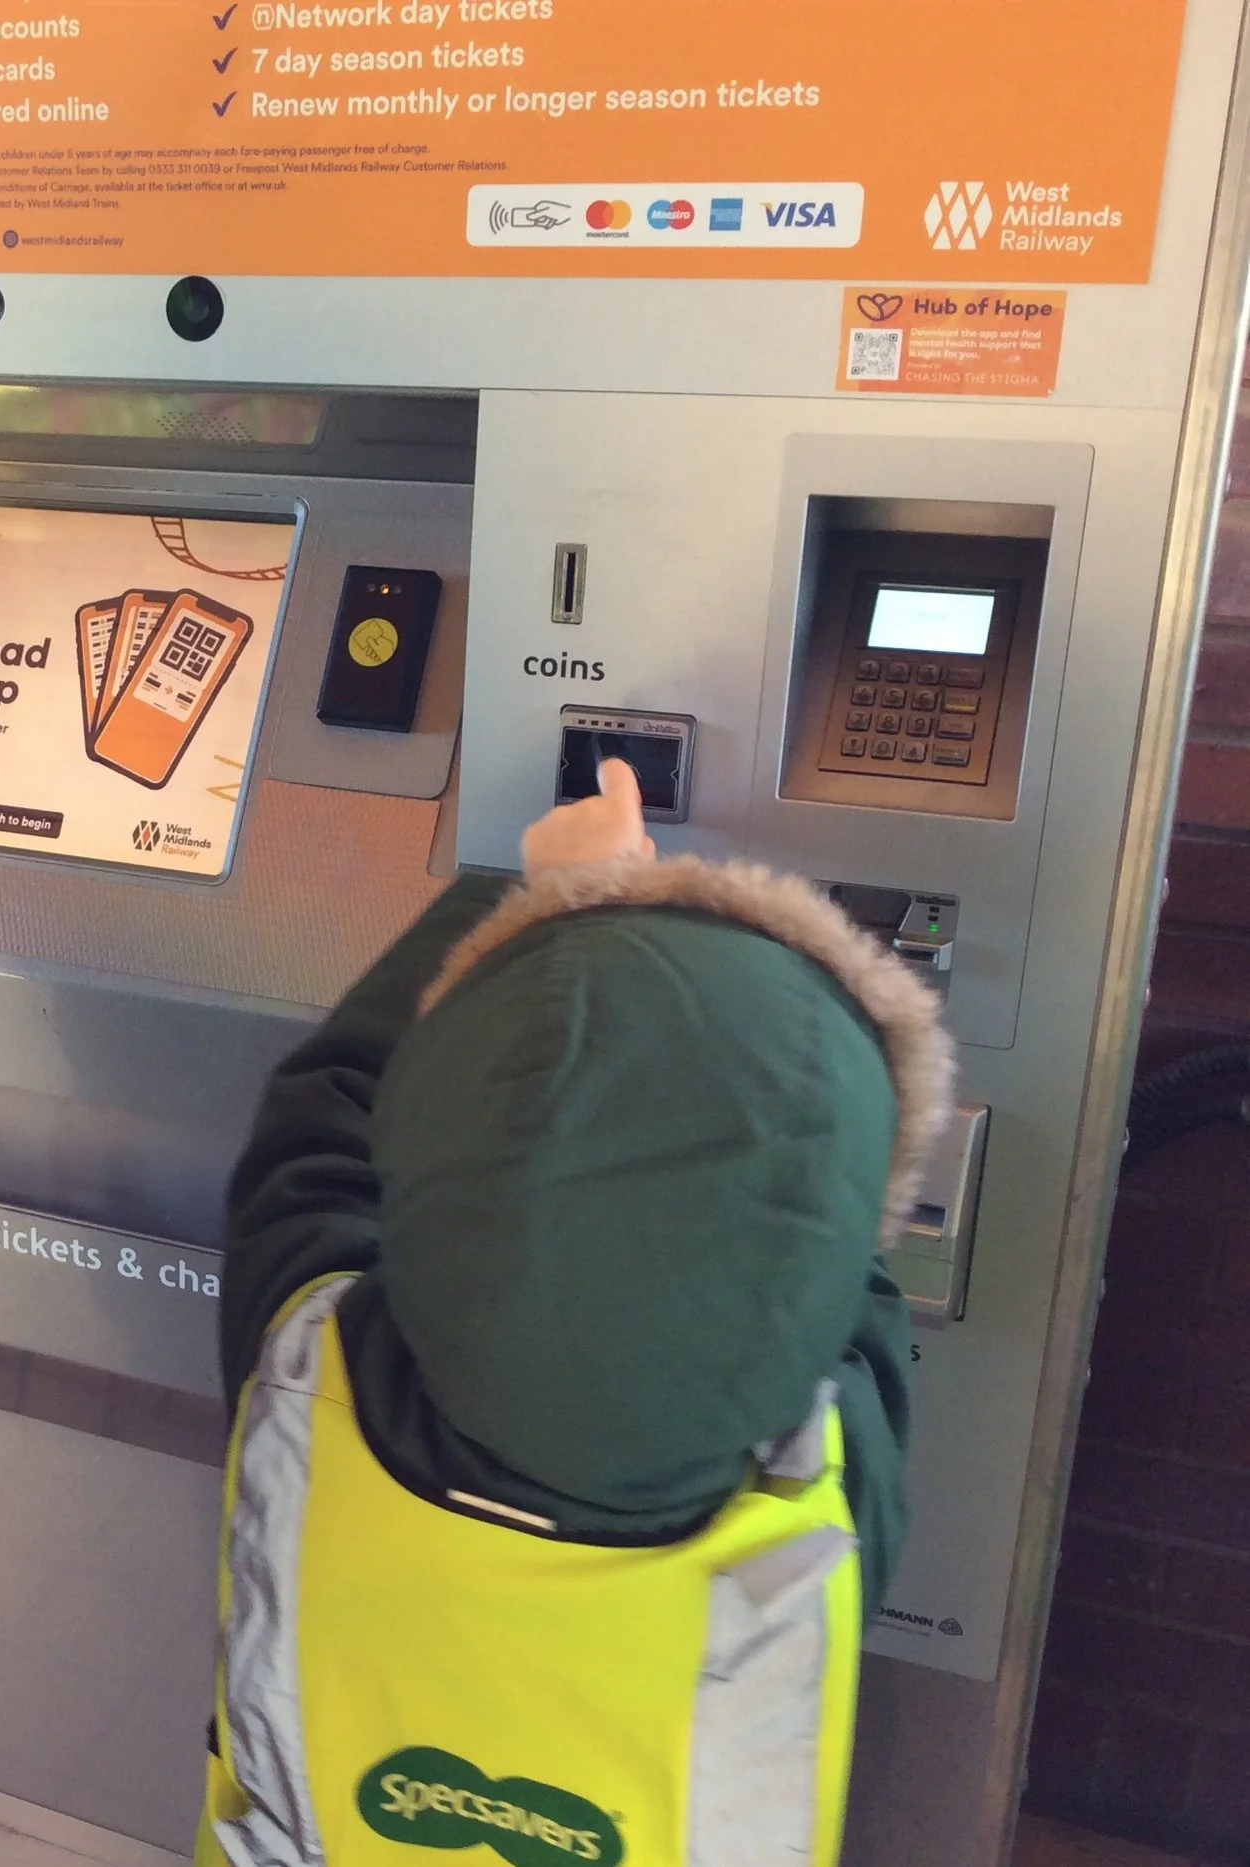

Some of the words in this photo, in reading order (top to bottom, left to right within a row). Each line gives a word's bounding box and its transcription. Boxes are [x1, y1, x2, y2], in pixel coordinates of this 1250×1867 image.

[400, 0, 450, 29] day
[458, 0, 554, 22] tickets
[251, 48, 269, 74] 7
[274, 47, 323, 78] day
[330, 49, 423, 72] season
[431, 41, 526, 69] tickets
[251, 91, 339, 118] Renew
[348, 86, 460, 120] monthly
[466, 93, 497, 113] or
[504, 85, 597, 118] longer
[605, 86, 707, 110] season
[717, 79, 821, 108] tickets
[37, 96, 110, 122] online
[0, 149, 37, 158] children
[38, 148, 65, 158] under
[76, 149, 101, 159] years
[102, 148, 113, 157] of
[114, 149, 133, 159] age
[134, 149, 153, 159] may
[156, 148, 211, 158] accompany
[214, 146, 238, 155] each
[240, 145, 297, 157] fare-paying
[299, 146, 351, 156] passenger
[354, 144, 376, 153] free
[377, 144, 390, 153] of
[391, 143, 431, 155] charge.
[31, 164, 73, 174] Relations
[75, 164, 100, 173] Team
[101, 164, 113, 175] by
[115, 163, 146, 175] calling
[148, 163, 175, 172] 0333
[177, 163, 192, 172] 311
[193, 162, 221, 172] 0039
[222, 164, 234, 172] or
[235, 162, 280, 173] Freepost
[282, 162, 308, 171] West
[310, 161, 358, 171] Midlands
[360, 161, 401, 172] Railway
[403, 160, 455, 170] Customer
[38, 181, 48, 191] of
[94, 181, 134, 190] available
[136, 181, 147, 190] at
[148, 181, 165, 190] the
[166, 180, 193, 190] ticket
[194, 180, 224, 190] office
[225, 182, 236, 190] or
[237, 180, 248, 190] at
[1005, 180, 1070, 203] West
[13, 198, 25, 209] by
[26, 198, 51, 207] West
[651, 209, 691, 221] Maestro
[759, 201, 837, 228] VISA
[1001, 205, 1123, 228] Midlands
[1000, 229, 1094, 256] Railway
[914, 297, 958, 316] Hub
[964, 297, 989, 316] of
[994, 299, 1053, 320] Hope
[910, 327, 959, 339] Download
[960, 329, 978, 339] the
[979, 331, 998, 341] app
[1000, 329, 1020, 339] and
[1021, 329, 1042, 340] find
[909, 339, 945, 348] mental
[946, 339, 977, 349] health
[979, 340, 1018, 351] support
[1019, 341, 1042, 350] that
[918, 349, 941, 360] right
[943, 350, 958, 359] for
[958, 351, 981, 362] you.
[905, 371, 961, 383] CHASING
[964, 372, 986, 384] THE
[989, 373, 1040, 385] STIGMA
[523, 651, 606, 682] coins
[7, 814, 20, 826] to
[21, 815, 52, 831] begin
[166, 823, 192, 835] West
[162, 833, 212, 849] Midlands
[160, 845, 200, 860] Railway
[116, 1247, 144, 1280] &
[158, 1259, 221, 1298] cha
[379, 1773, 602, 1861] Specsavers
